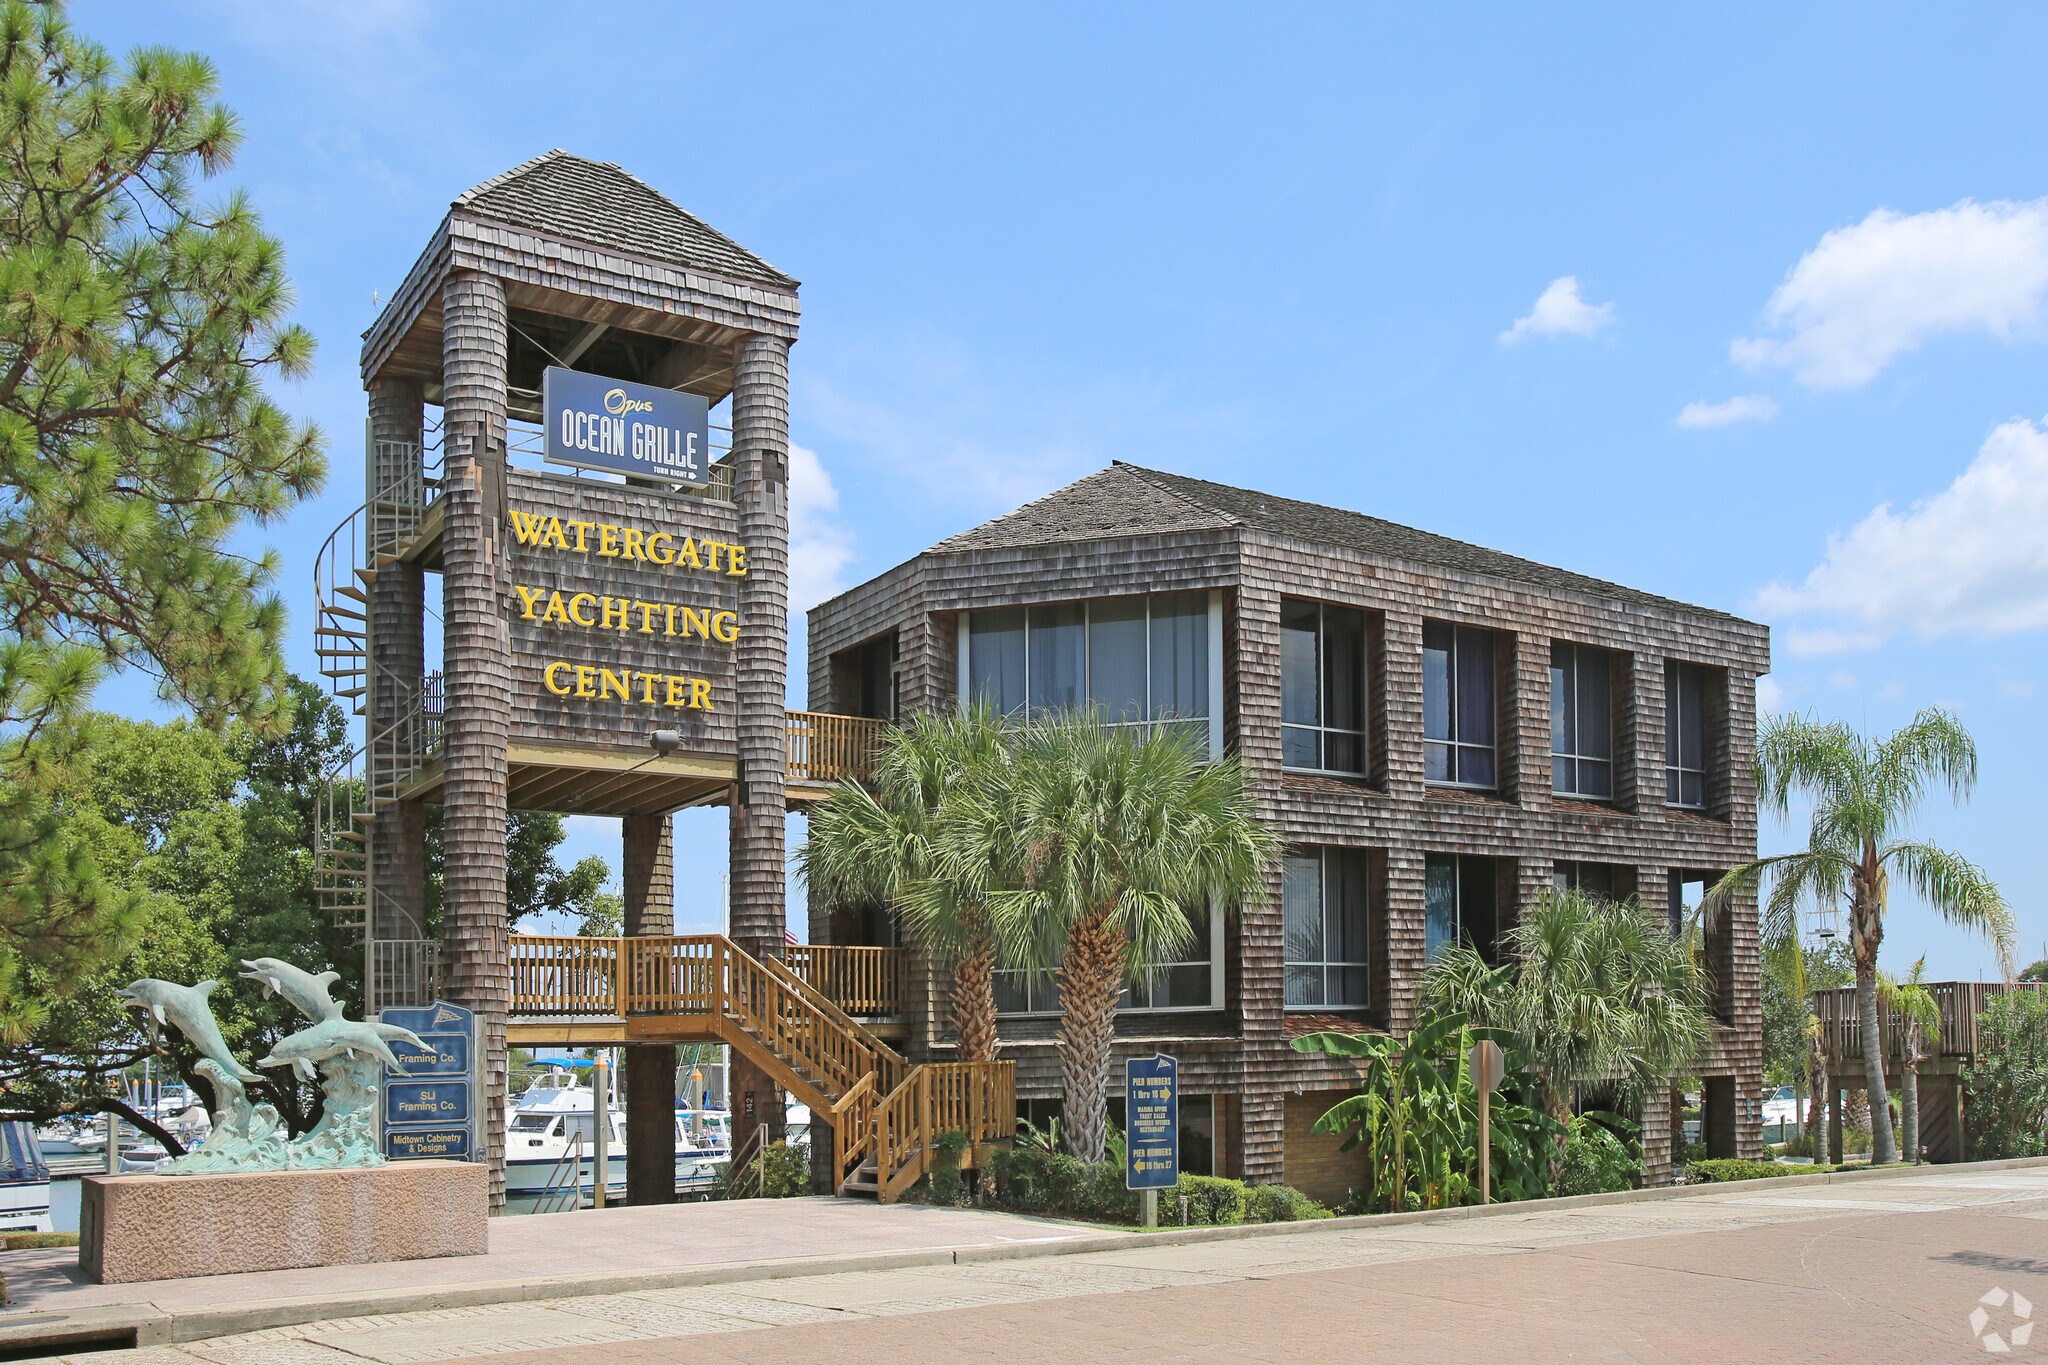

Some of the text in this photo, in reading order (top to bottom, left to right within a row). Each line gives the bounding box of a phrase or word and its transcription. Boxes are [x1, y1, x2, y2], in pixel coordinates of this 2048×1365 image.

[604, 388, 654, 419] Opus
[562, 408, 698, 470] OCEAN GRILLE
[653, 466, 687, 478] TURN RIGHT
[508, 509, 748, 577] WATERGATE
[515, 585, 741, 643] YACHTING
[543, 661, 714, 710] CENTER
[399, 1053, 456, 1064] Framing Co.
[1132, 1076, 1172, 1086] PIER NUMBERS
[420, 1091, 436, 1101] SLI
[1138, 1090, 1150, 1099] thru
[399, 1101, 457, 1112] Framing Co.
[745, 1097, 753, 1112] 142
[393, 1133, 462, 1144] Midtown Cabinetry
[408, 1143, 447, 1153] & Designs
[1133, 1148, 1172, 1158] PIER NUMBERS
[1153, 1161, 1164, 1170] thru
[1164, 1160, 1172, 1169] 27
